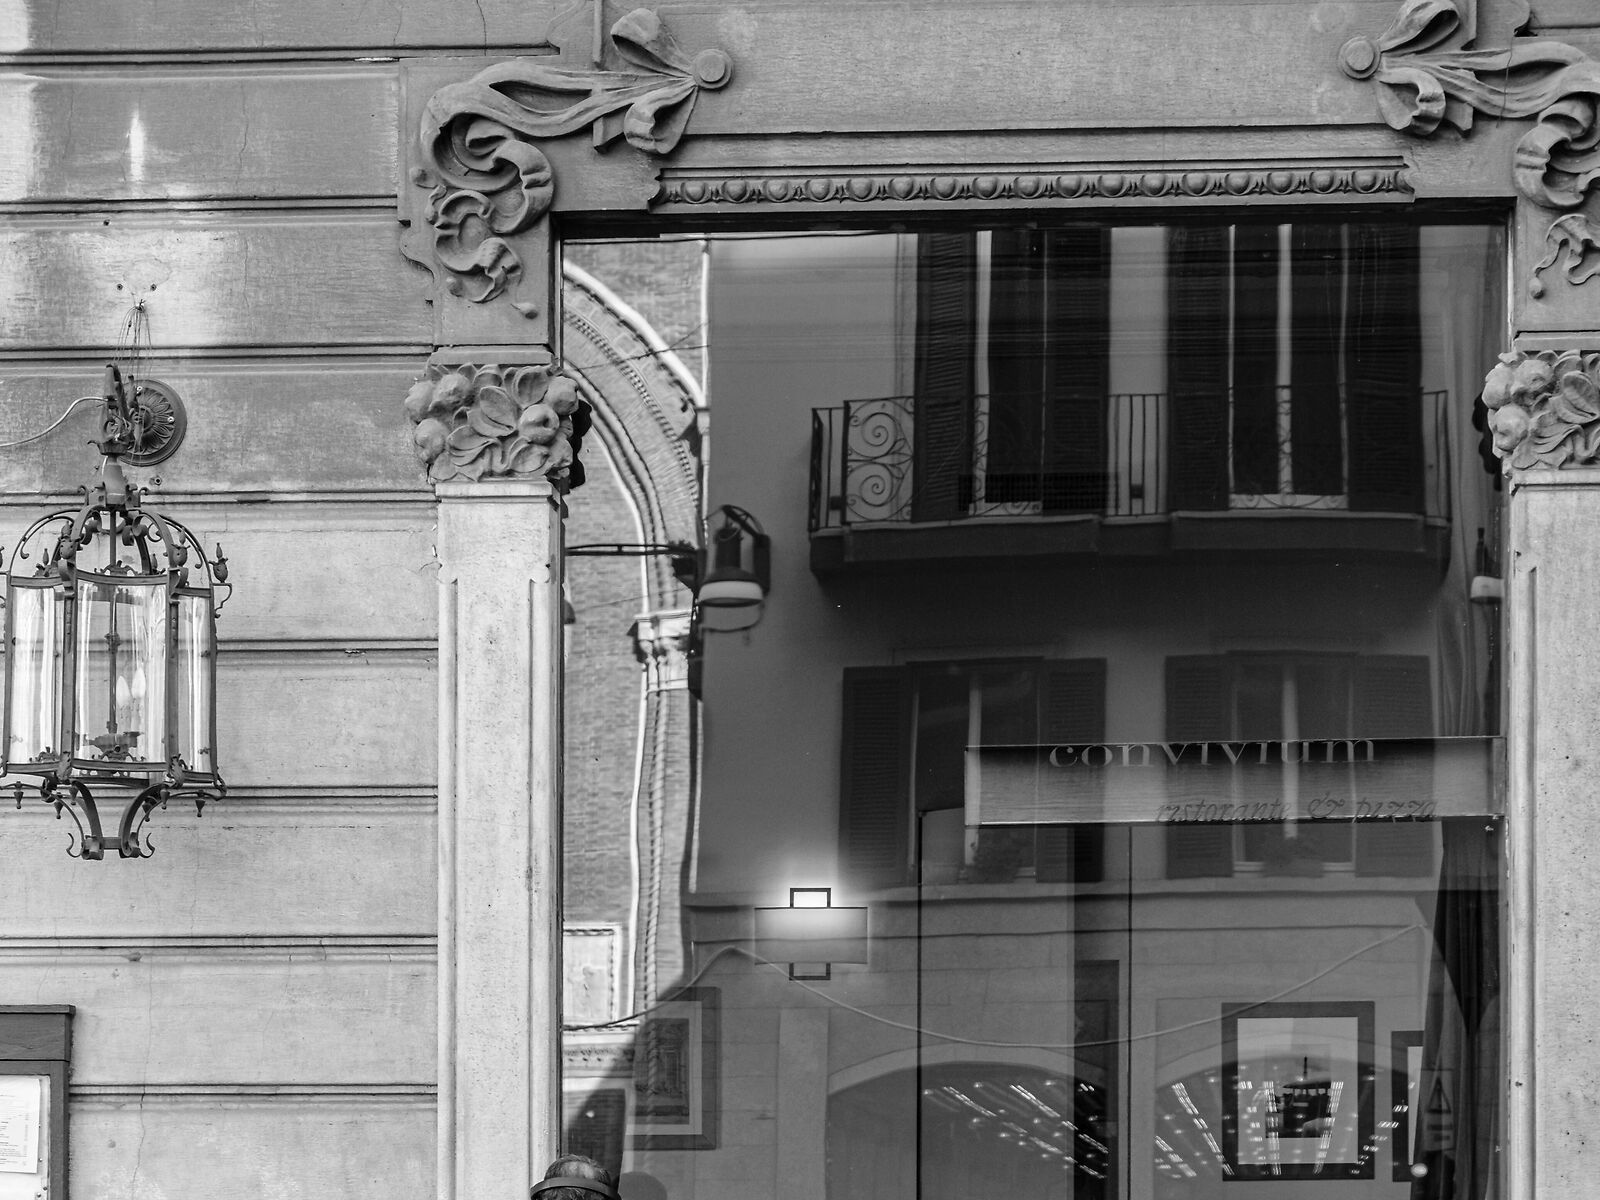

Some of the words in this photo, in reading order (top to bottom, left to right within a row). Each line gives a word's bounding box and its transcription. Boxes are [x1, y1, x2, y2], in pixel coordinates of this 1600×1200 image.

[1050, 740, 1380, 766] convivium
[1156, 799, 1289, 822] ristorante
[1309, 792, 1345, 819] &
[1353, 798, 1436, 823] pizza
